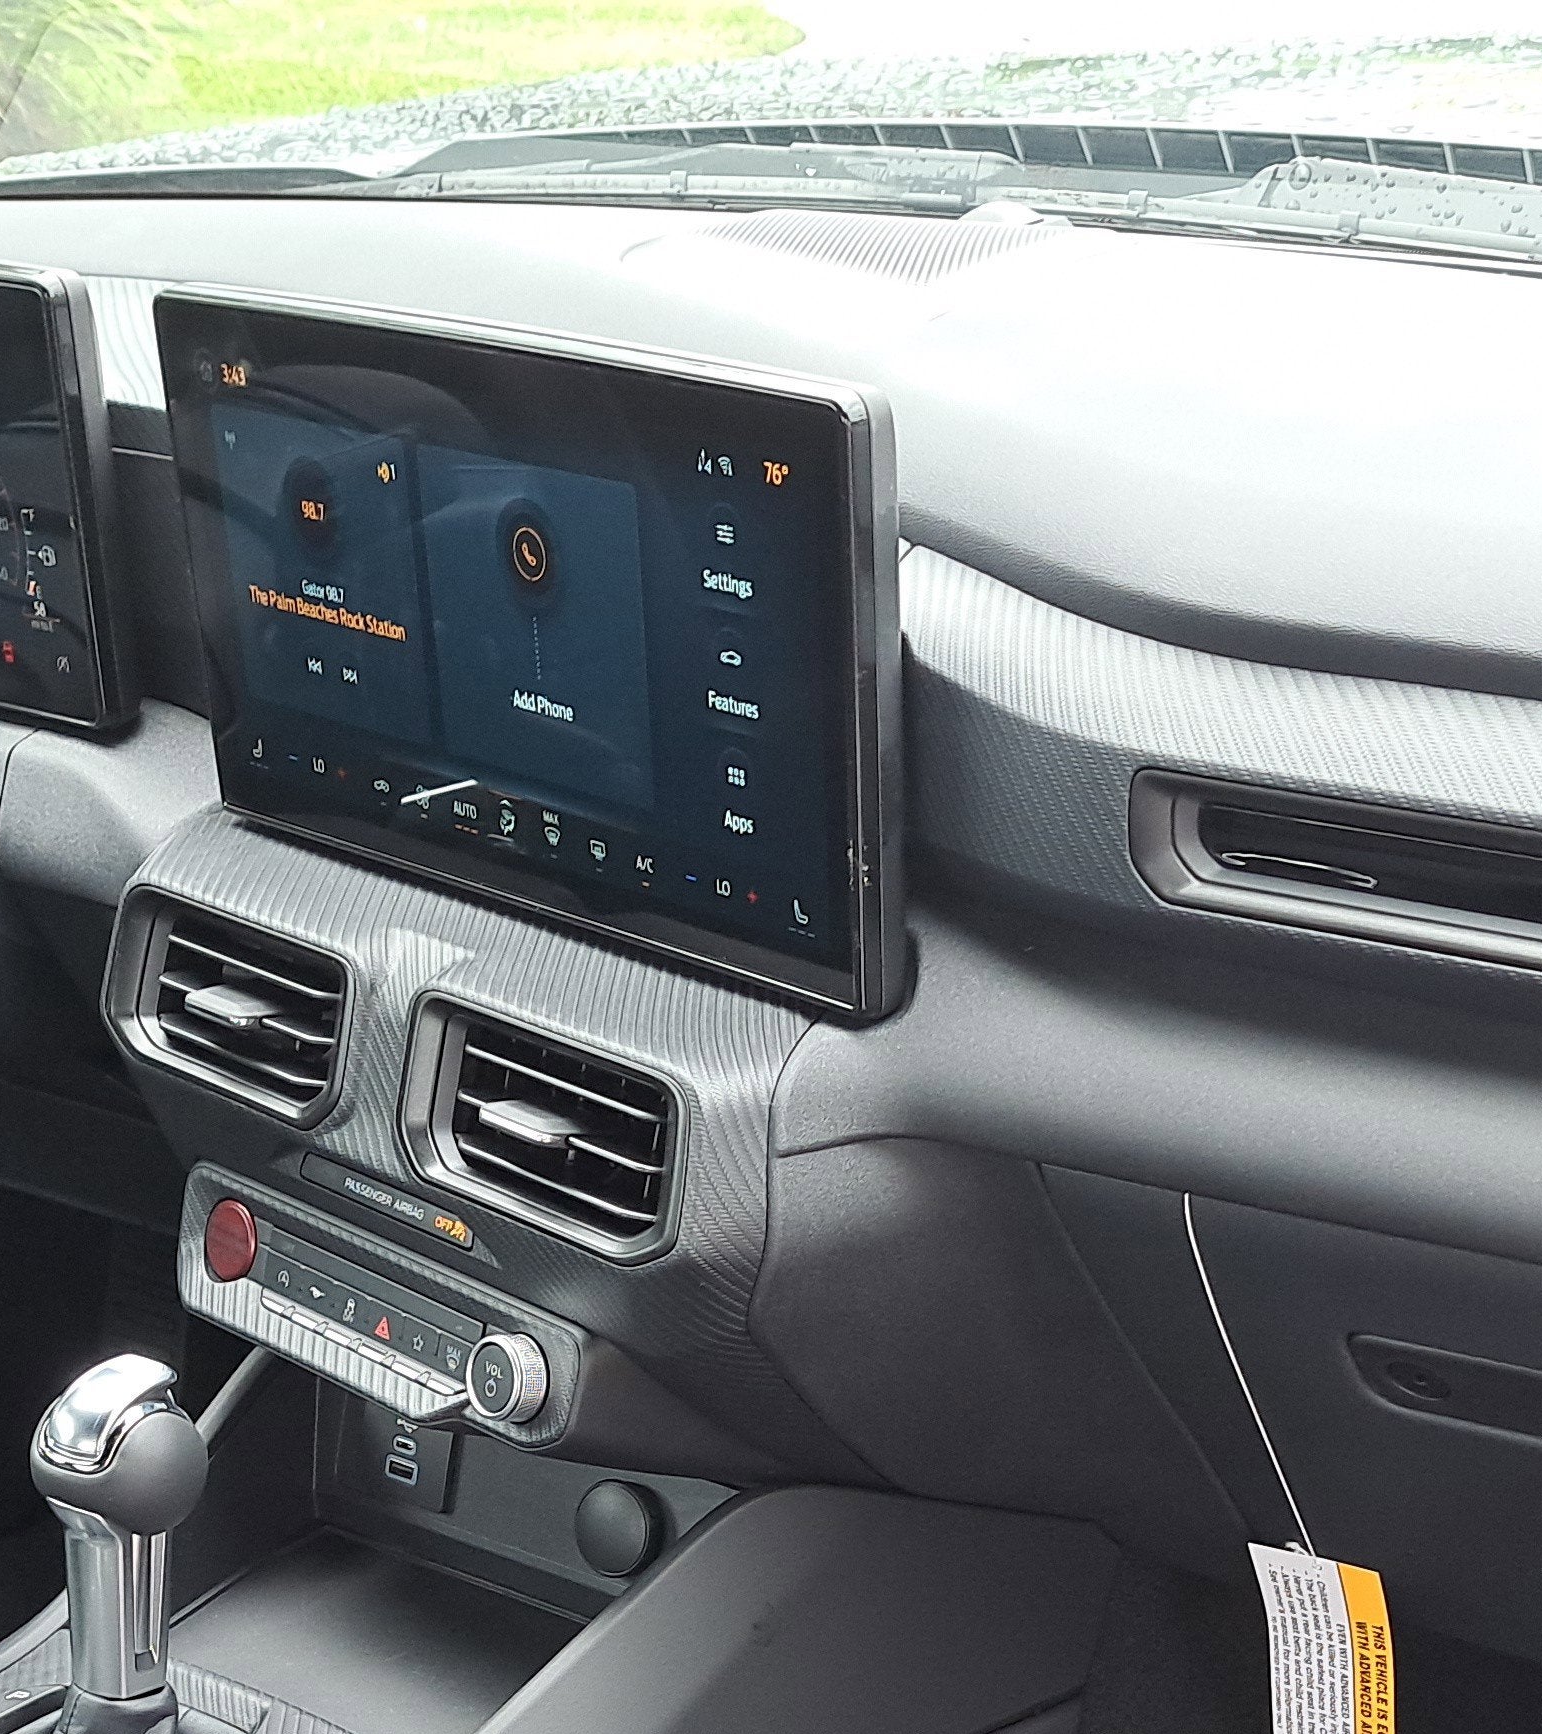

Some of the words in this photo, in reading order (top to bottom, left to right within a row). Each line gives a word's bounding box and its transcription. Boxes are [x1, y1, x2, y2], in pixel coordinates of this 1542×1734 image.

[220, 362, 248, 388] 3:43
[300, 500, 325, 522] 98.7
[702, 568, 755, 600] Settings
[249, 584, 269, 607] The
[268, 589, 297, 613] Palm
[295, 596, 339, 625] Beaches
[339, 606, 367, 631] Rock
[365, 614, 408, 642] Station
[512, 688, 537, 713] Add
[536, 694, 575, 723] Phone
[707, 689, 760, 720] Features
[453, 800, 479, 820] AUTO
[723, 809, 756, 835] Apps
[635, 854, 655, 875] A/C
[715, 878, 731, 898] LO
[343, 1176, 394, 1208] PASSENGER
[392, 1197, 426, 1221] AIRBAG
[484, 1361, 504, 1380] VOL
[1355, 1622, 1370, 1651] WITH
[1371, 1625, 1386, 1650] THIS
[1359, 1652, 1371, 1718] ADVANCED
[1375, 1654, 1387, 1706] VEHICLE
[1377, 1708, 1387, 1720] IS
